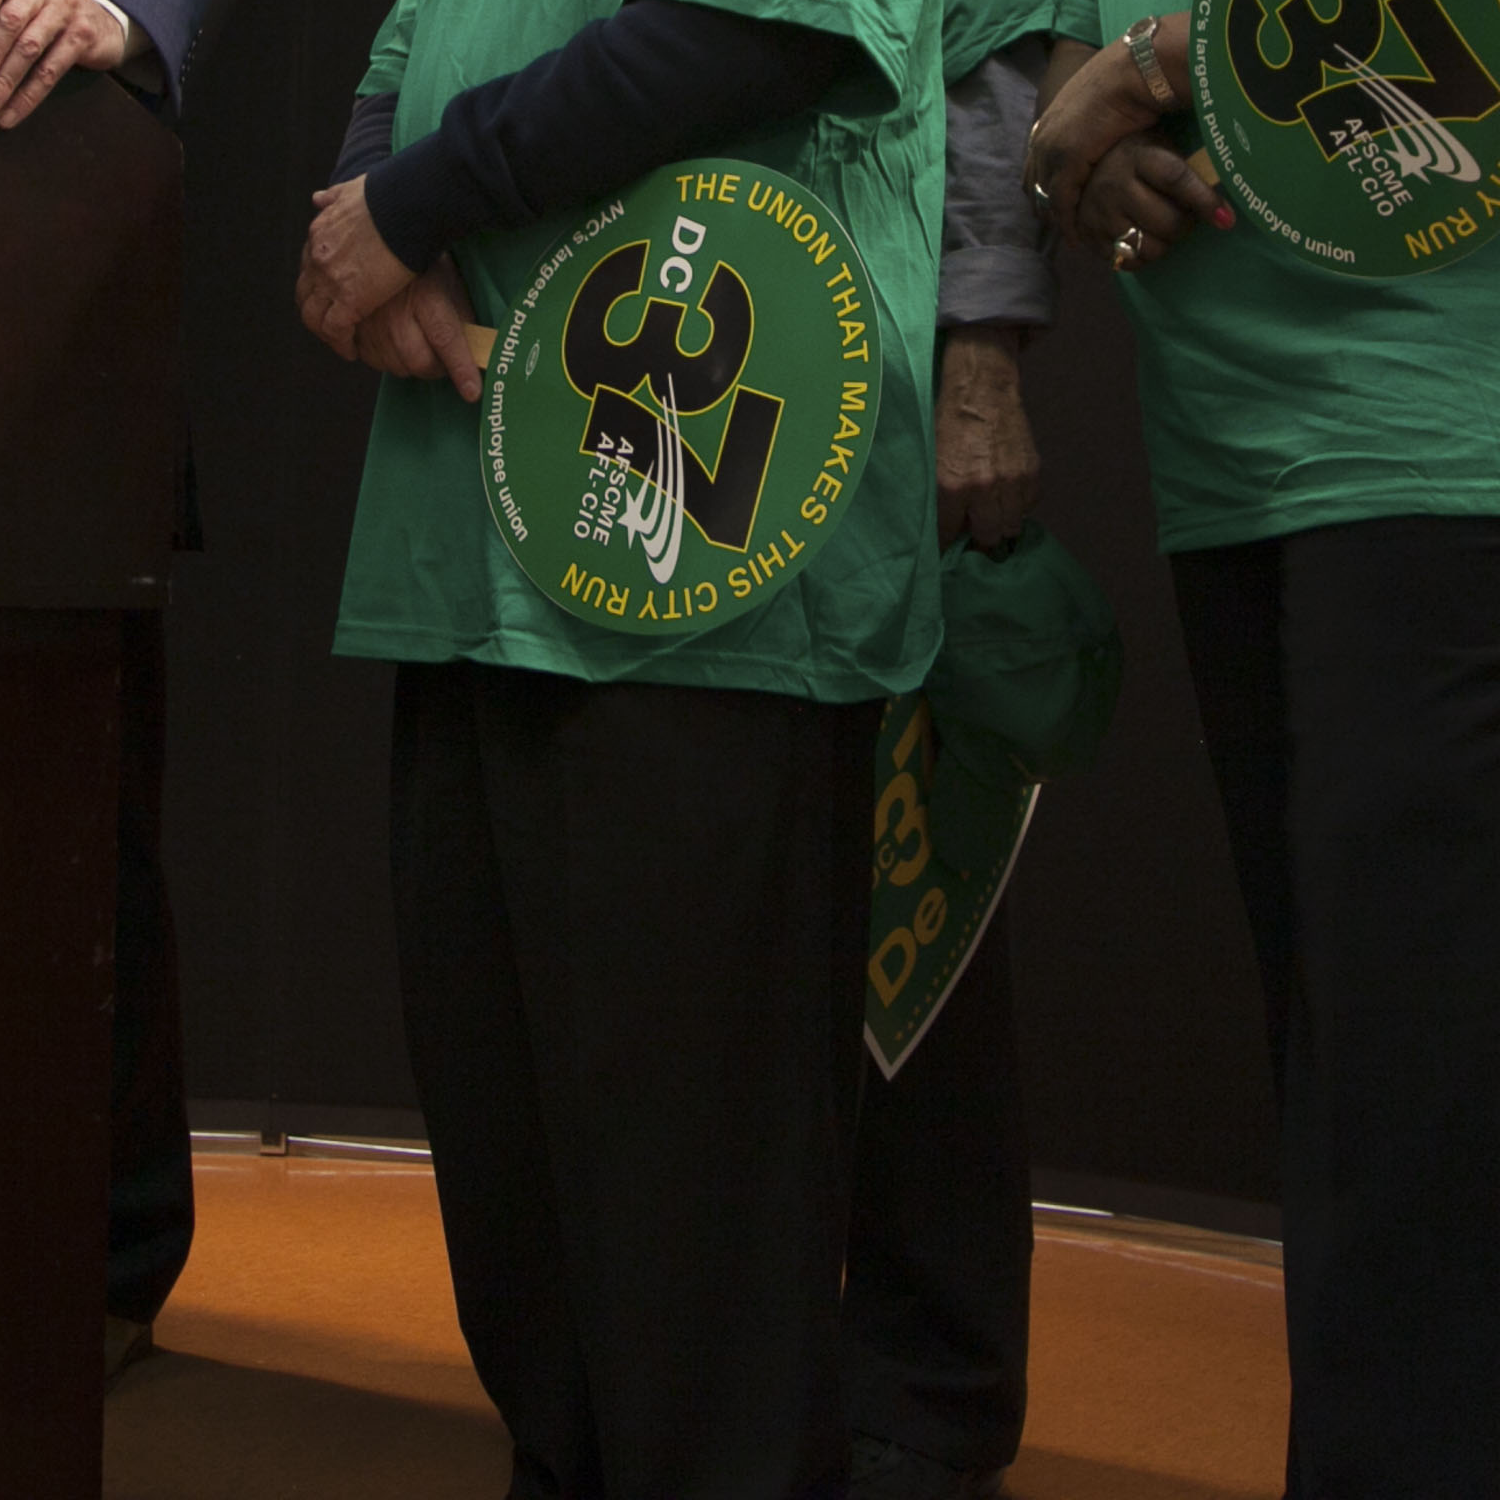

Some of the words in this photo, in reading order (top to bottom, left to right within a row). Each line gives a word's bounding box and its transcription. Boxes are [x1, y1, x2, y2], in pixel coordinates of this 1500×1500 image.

[1195, 38, 1214, 108] largest
[1203, 112, 1235, 172] public
[1330, 129, 1395, 217] AFL-CIO
[1345, 118, 1413, 206] AFSCME
[572, 200, 625, 244] NYC's
[676, 174, 740, 202] THE
[748, 181, 836, 265] UNION
[1232, 173, 1301, 244] employee
[659, 215, 706, 293] DC
[1305, 237, 1356, 263] union
[1405, 207, 1478, 260] RUN
[523, 244, 574, 308] largest
[497, 309, 527, 375] public
[826, 263, 869, 363] THAT
[562, 239, 784, 552] 37
[487, 380, 506, 483] employee
[800, 381, 869, 526] MAKES
[498, 486, 529, 542] union
[574, 431, 615, 539] AFL-CIO
[592, 436, 634, 546] AFSCME
[561, 563, 630, 616] RUN
[728, 529, 806, 598] THIS
[638, 581, 718, 619] CITY
[868, 887, 947, 1008] De
